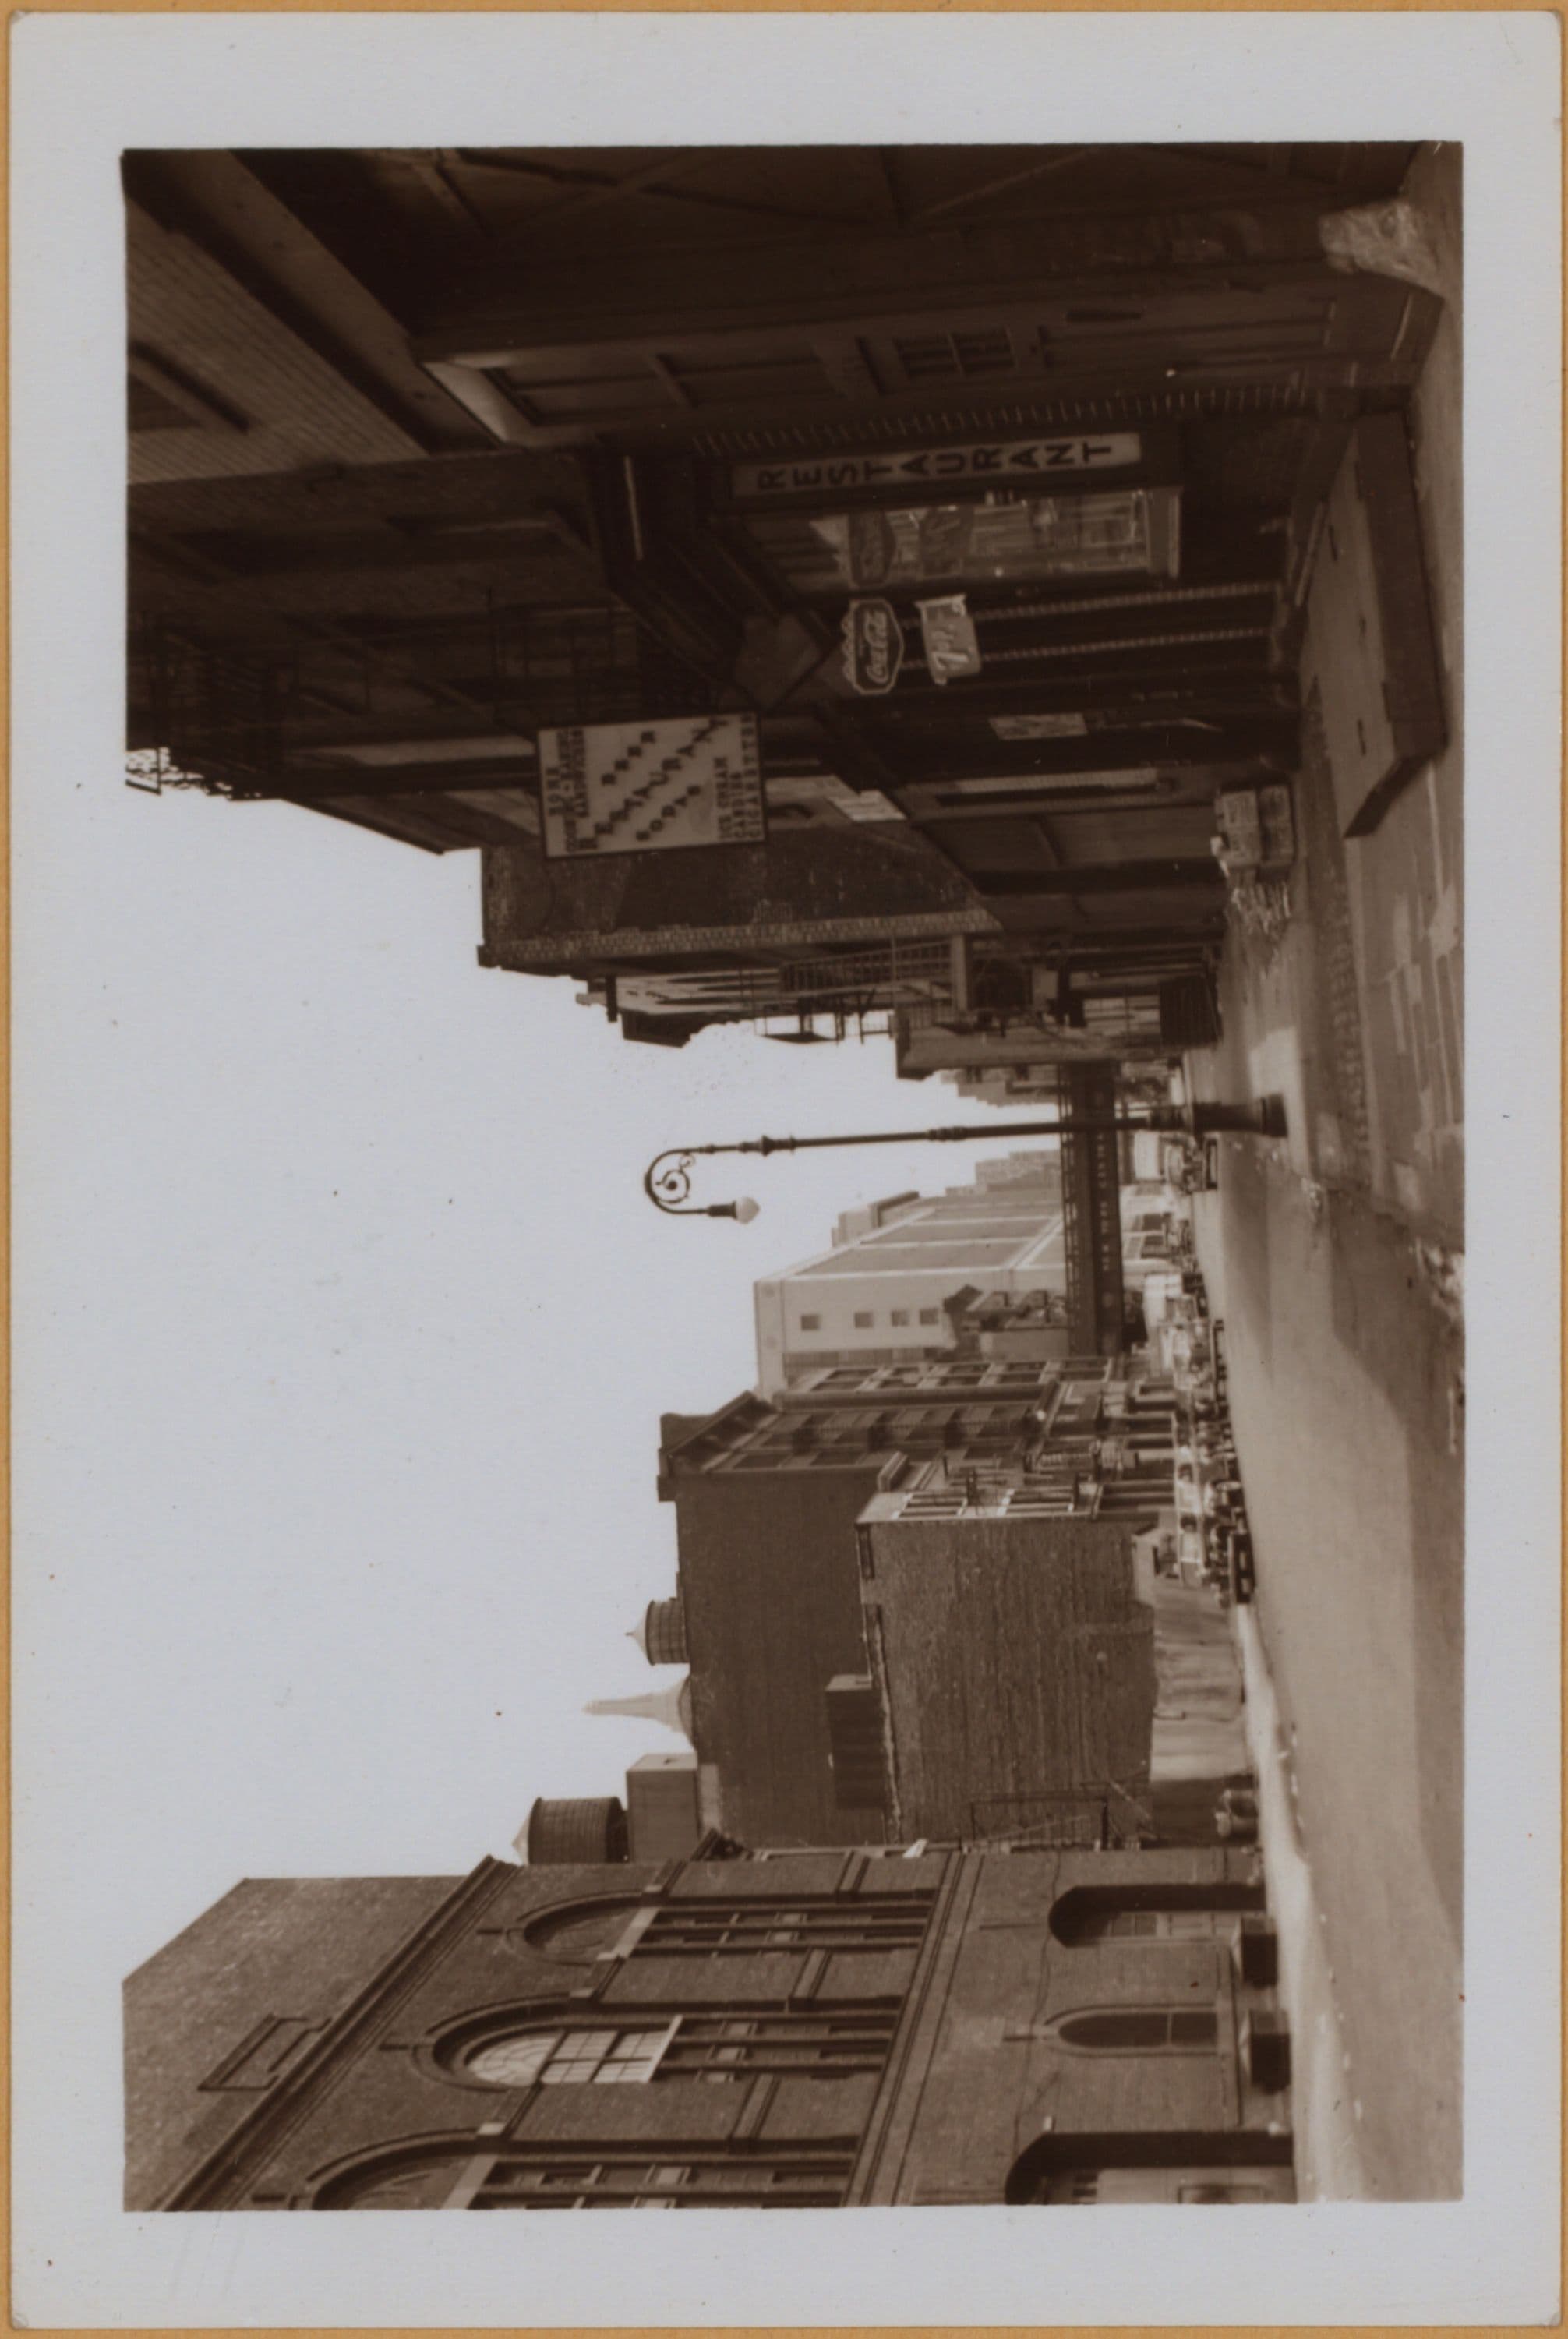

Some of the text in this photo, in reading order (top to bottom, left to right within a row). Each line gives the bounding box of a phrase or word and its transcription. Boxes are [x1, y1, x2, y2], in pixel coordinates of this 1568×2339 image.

[756, 443, 1112, 490] RESTAURANT
[572, 730, 589, 818] SANDWICHES
[578, 719, 729, 850] RESTAURANT
[600, 730, 656, 786] BEER
[740, 715, 761, 838] CIGARETTES
[635, 785, 701, 842] SODAS
[713, 757, 732, 839] ICE CREAM
[729, 772, 746, 839] CANDIES
